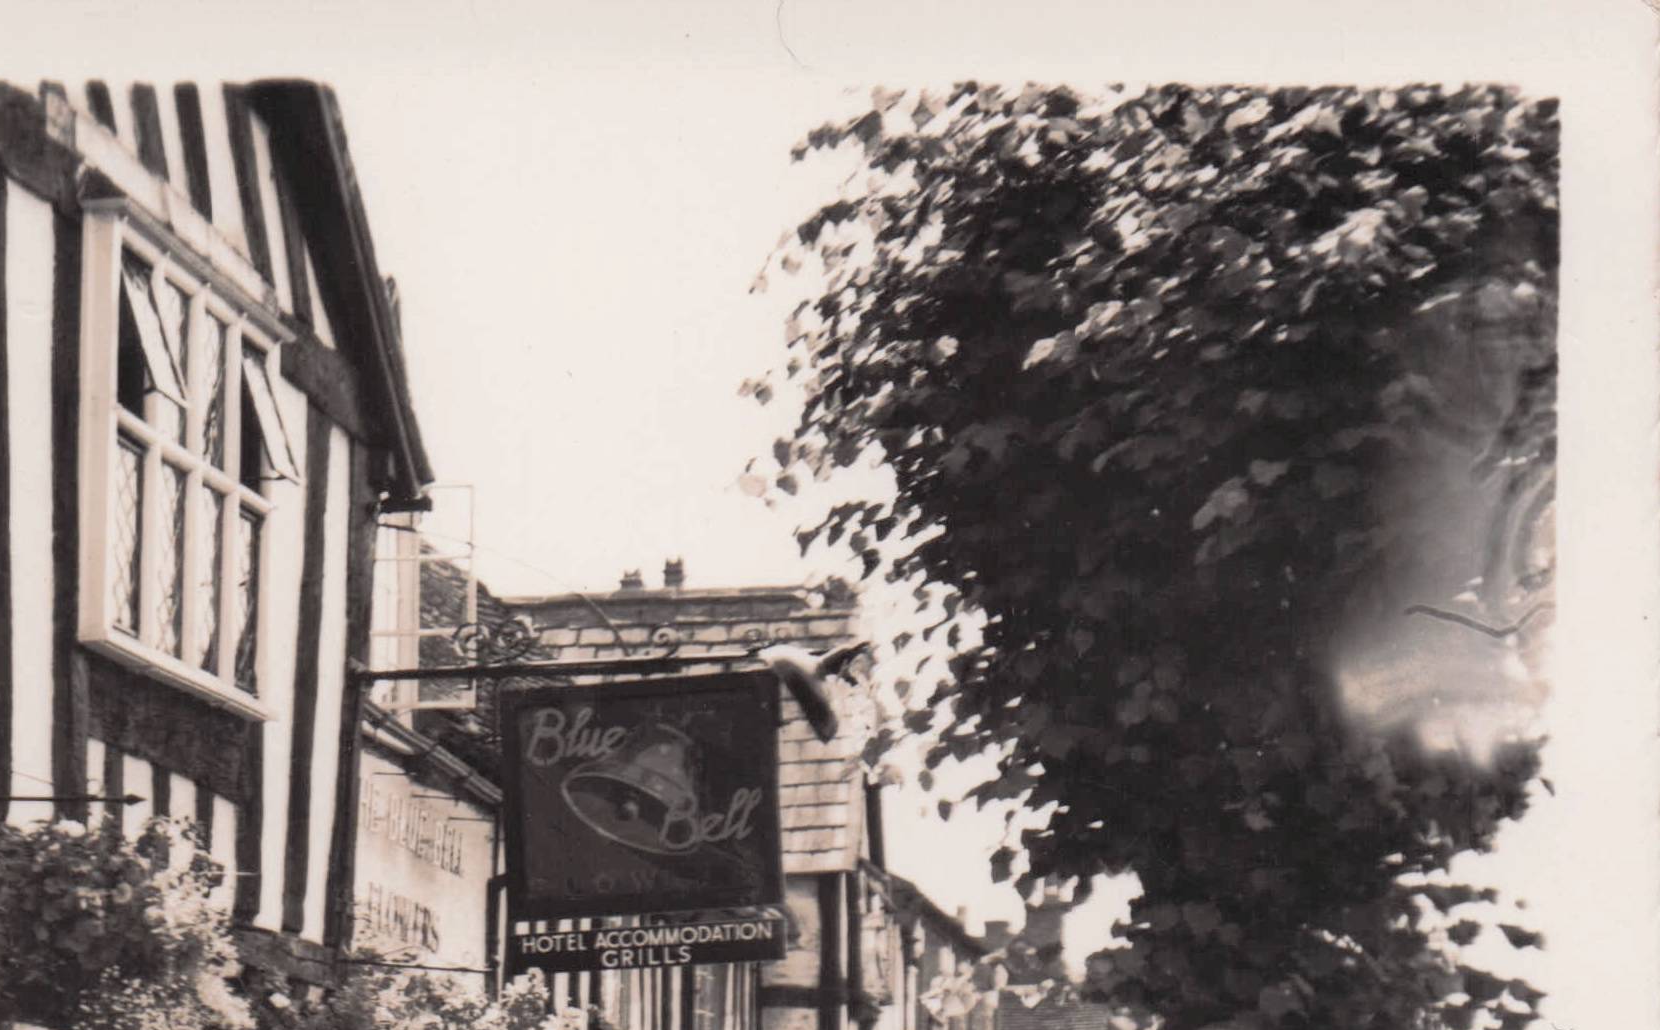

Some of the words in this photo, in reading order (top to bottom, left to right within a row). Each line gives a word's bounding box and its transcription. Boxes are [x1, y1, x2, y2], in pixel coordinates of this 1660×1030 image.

[527, 708, 627, 766] Blue
[660, 788, 762, 849] Bell
[521, 933, 588, 954] HOTEL
[594, 922, 772, 950] ACCOMMODATION
[601, 945, 692, 968] GRILLS
